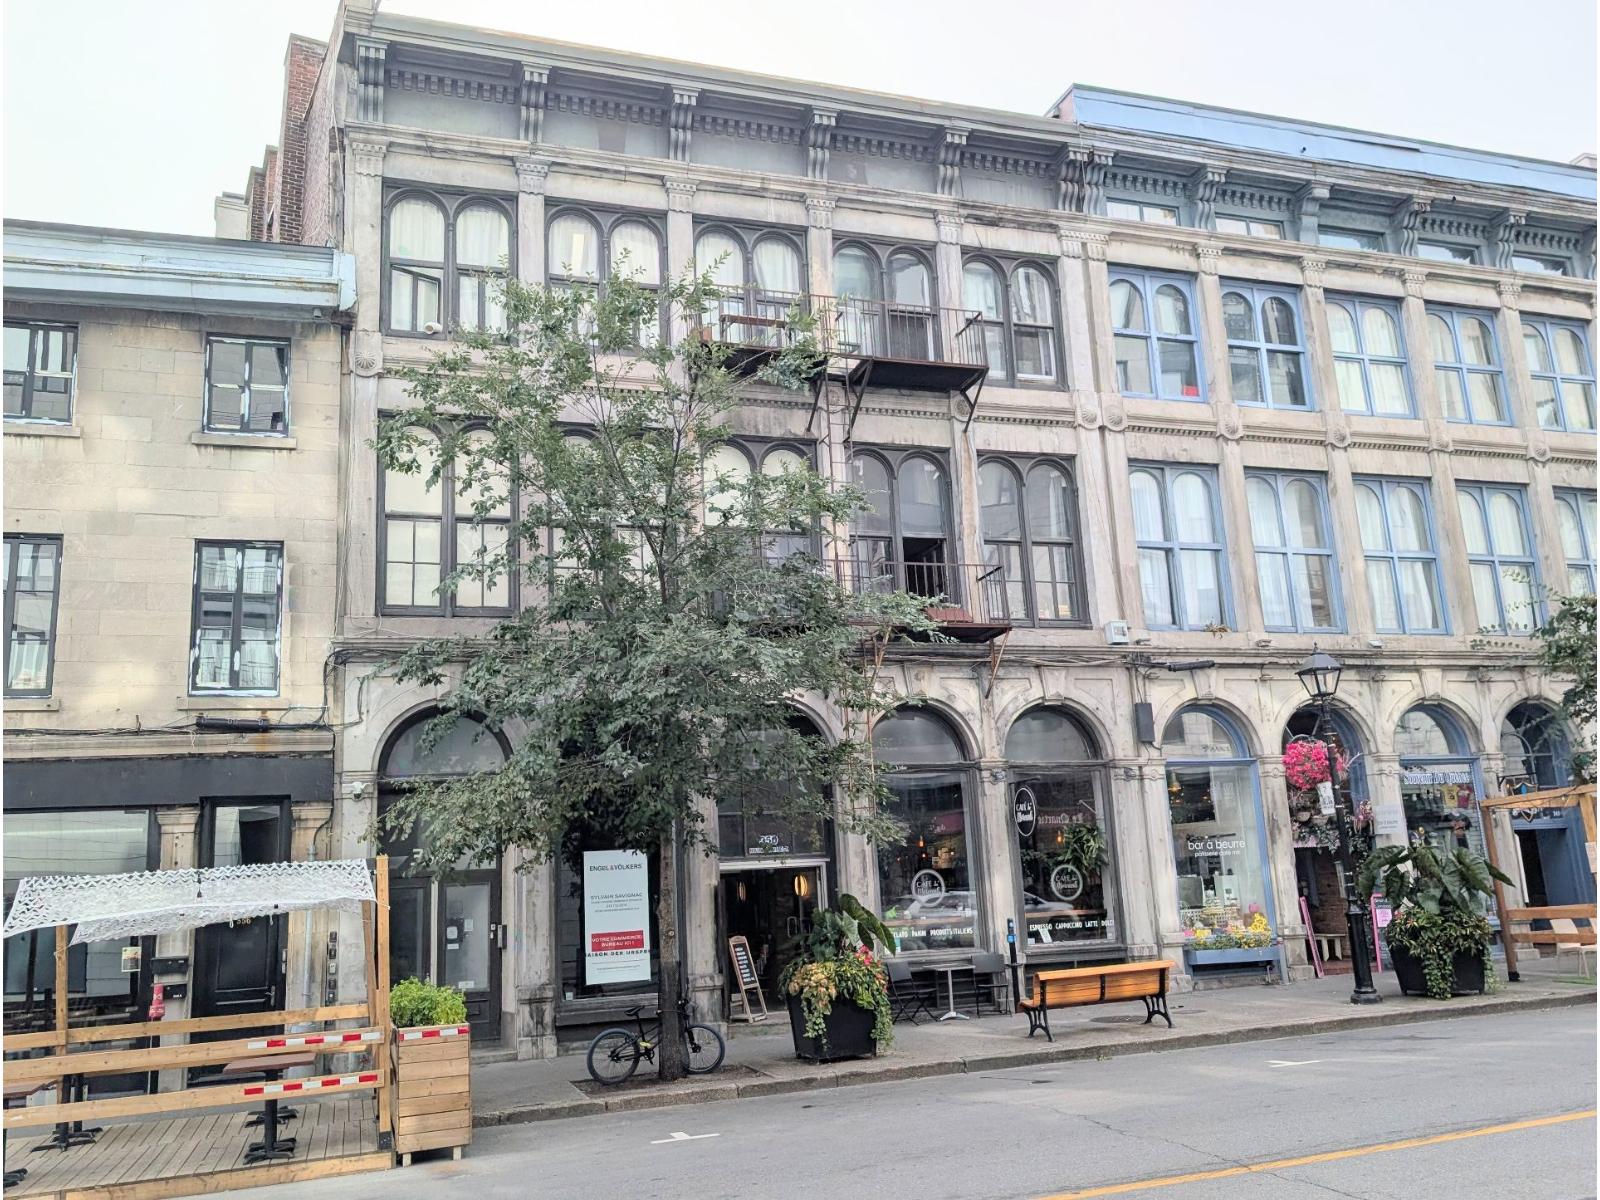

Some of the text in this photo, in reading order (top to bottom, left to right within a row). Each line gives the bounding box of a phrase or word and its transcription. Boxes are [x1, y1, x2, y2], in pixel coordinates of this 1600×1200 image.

[1187, 840, 1204, 850] bar
[1215, 839, 1246, 849] beurre
[1029, 923, 1053, 932] ESPRESSO
[1055, 920, 1083, 930] CAPPUCCINO
[1085, 920, 1099, 928] LATTE
